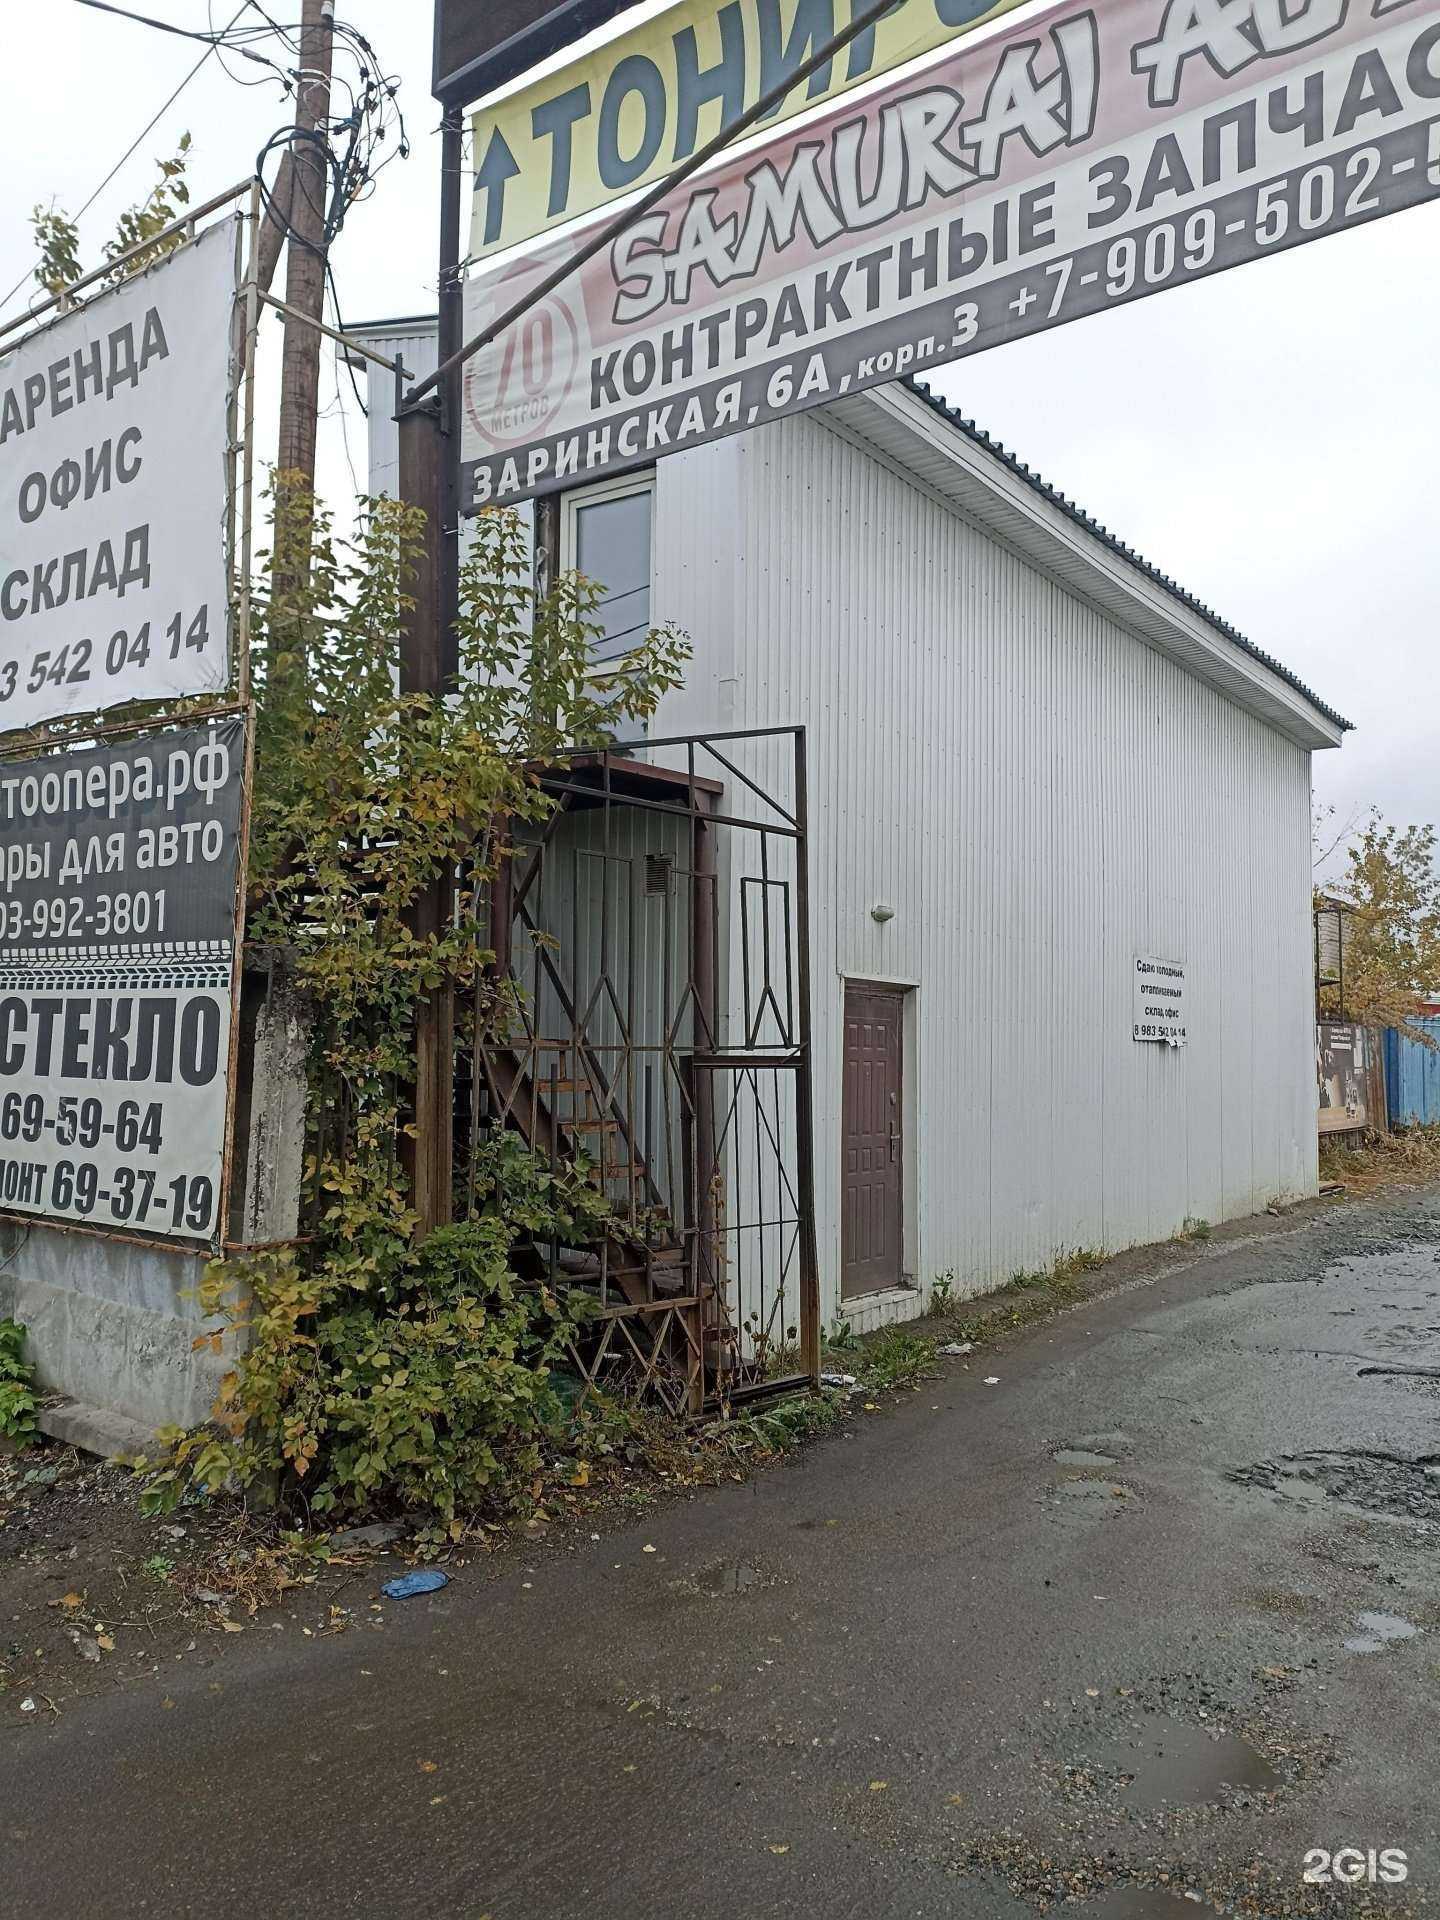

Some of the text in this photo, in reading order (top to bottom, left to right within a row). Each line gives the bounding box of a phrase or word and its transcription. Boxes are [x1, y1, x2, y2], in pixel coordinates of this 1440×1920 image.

[531, 0, 1003, 218] ТОНИР
[611, 9, 1099, 324] SAMURAI
[590, 181, 1056, 410] КОНТРАКТНЫЕ
[0, 306, 170, 444] АРЕНДА
[18, 426, 142, 523] ОФИС
[1, 523, 150, 621] СКЛАД
[27, 638, 93, 694] 542
[105, 621, 150, 676] 04
[166, 604, 209, 659] 14
[2, 730, 230, 819] тоопера.рф
[58, 832, 125, 886] для
[136, 819, 224, 869] авто
[0, 995, 221, 1087] СТЕКЛО
[1, 1092, 163, 1155] 69-59-64
[0, 1159, 213, 1232] ОНТ 69-37-19
